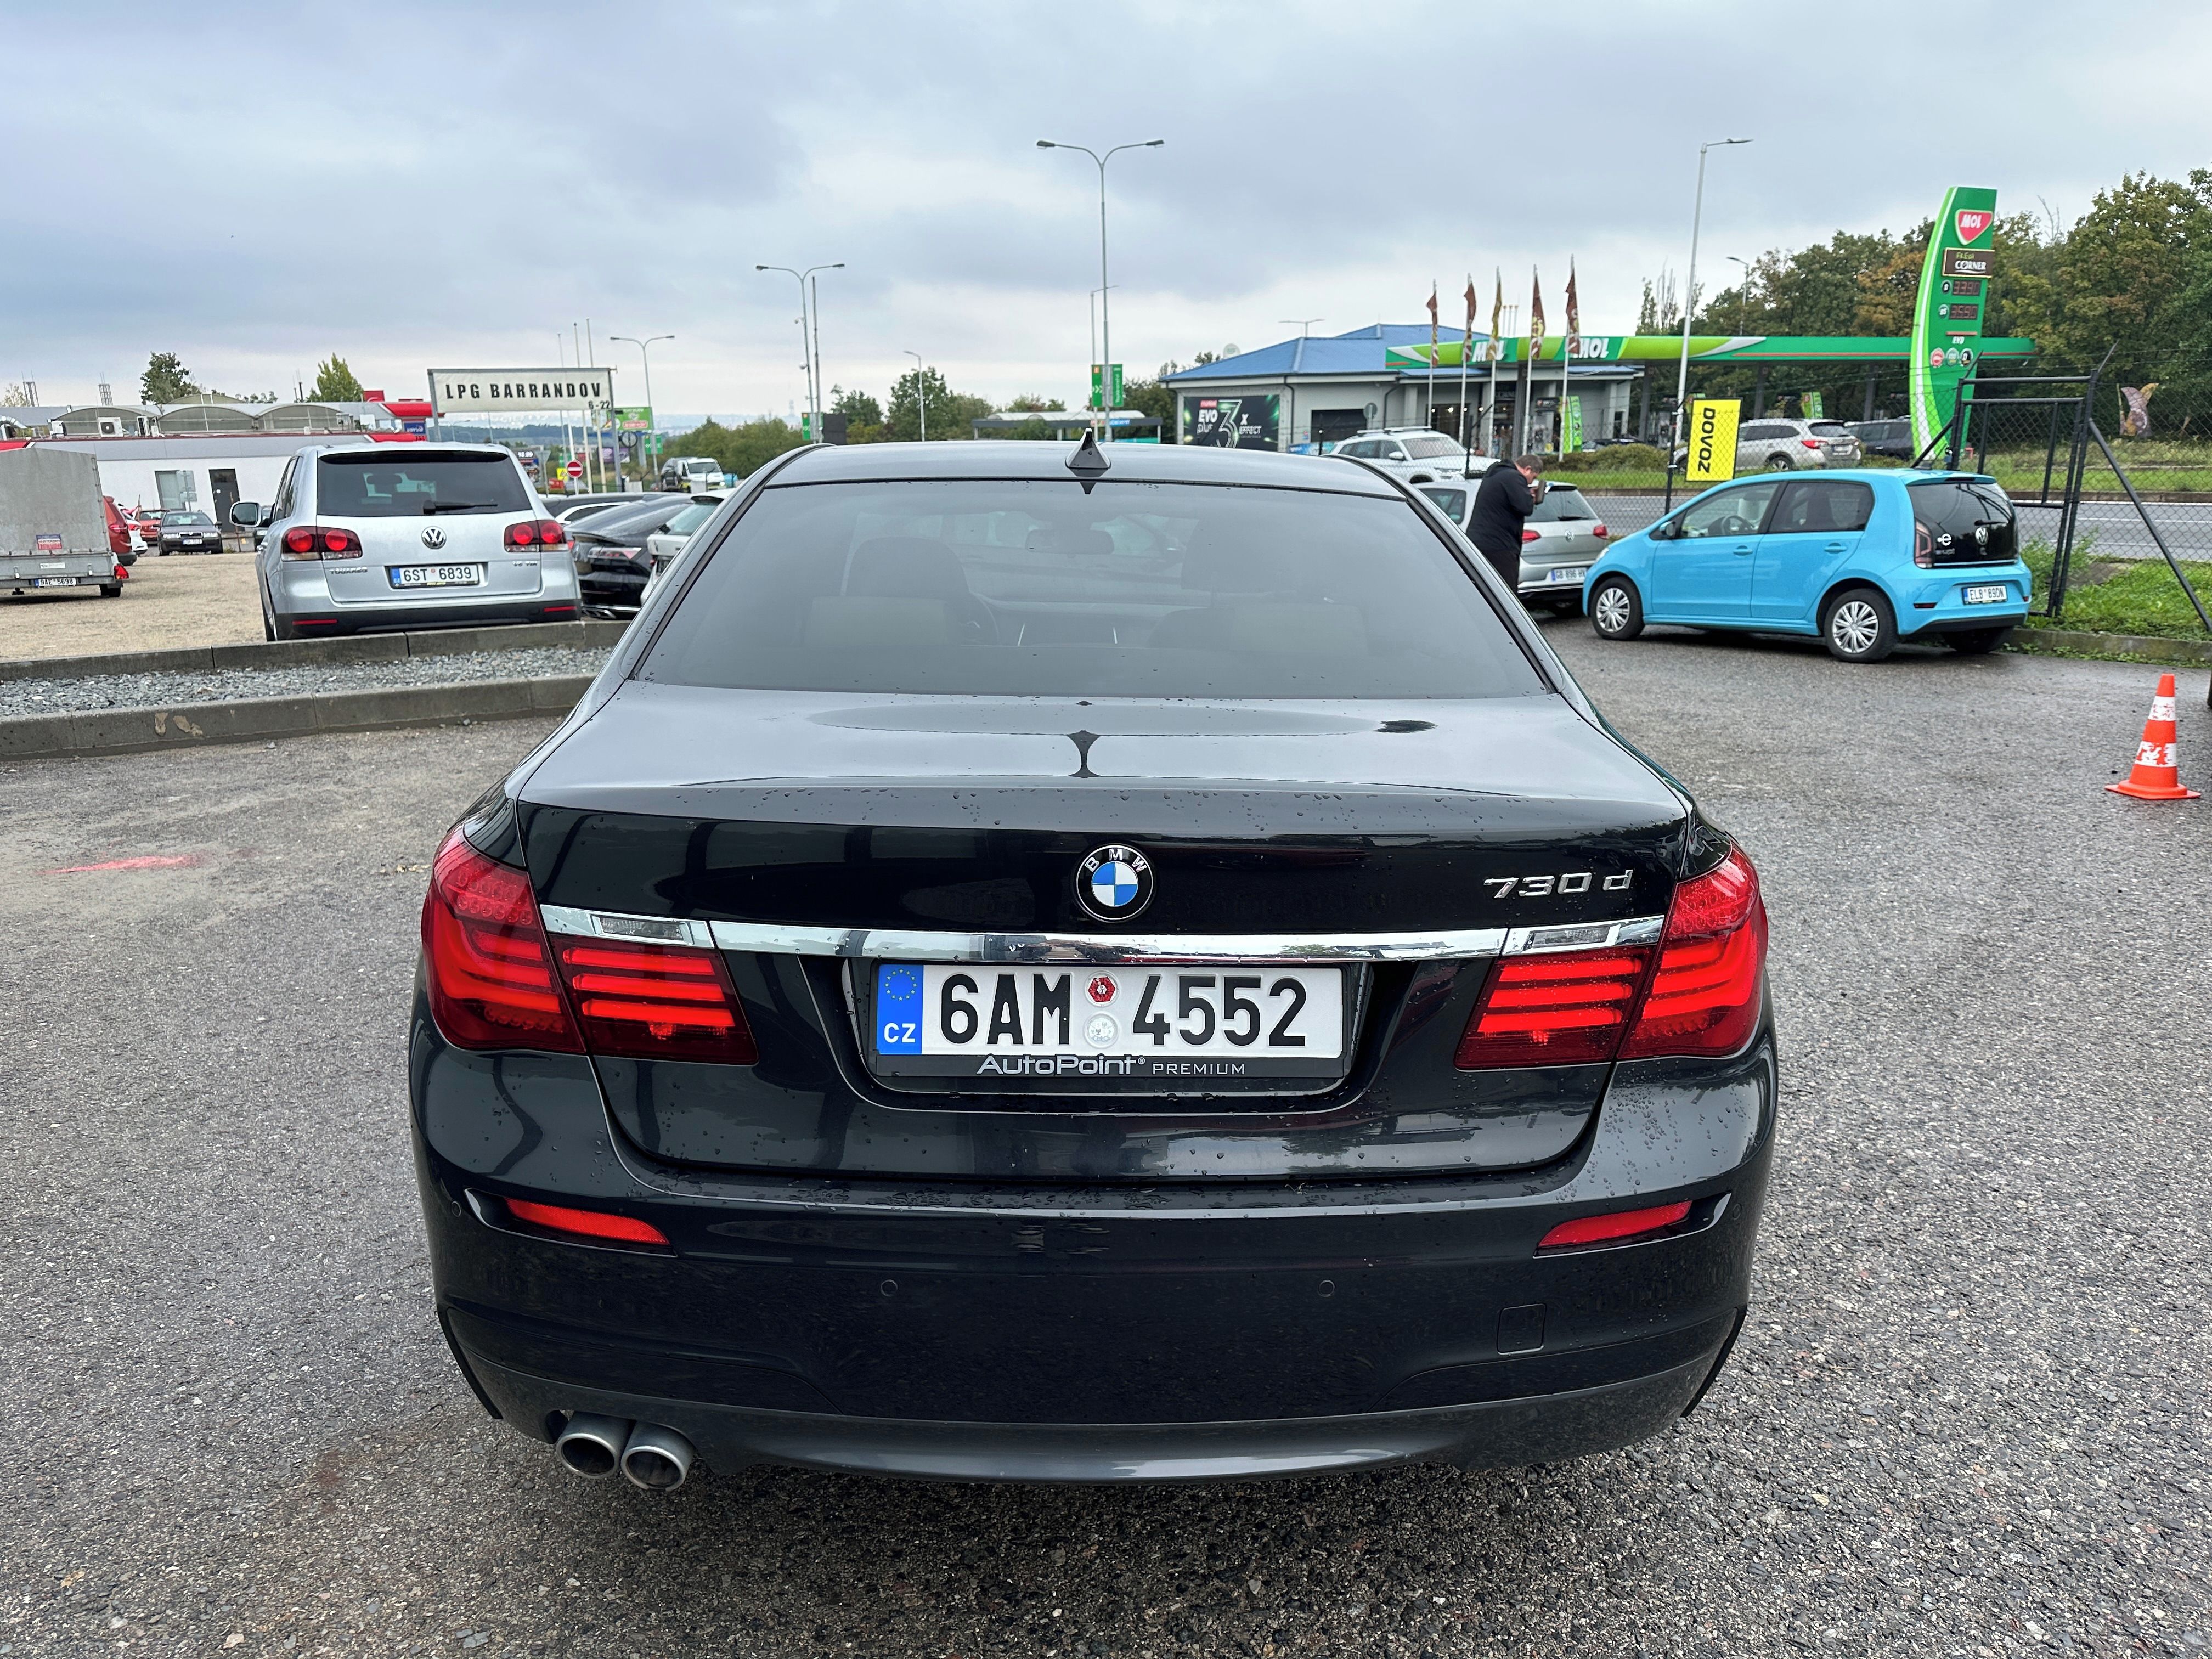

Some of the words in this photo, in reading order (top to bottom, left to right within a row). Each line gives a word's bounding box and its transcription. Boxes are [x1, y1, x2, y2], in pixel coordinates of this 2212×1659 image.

[1960, 214, 1982, 228] MOL
[1954, 260, 1987, 270] CORNER
[1472, 340, 1505, 362] ML
[445, 384, 480, 399] LPG
[490, 383, 601, 399] BARRANDOV
[1198, 409, 1218, 422] EVO
[1239, 425, 1262, 435] EFFECT
[1697, 407, 1716, 473] DOVOZ
[403, 569, 428, 582] 6ST
[438, 567, 472, 582] 6839
[1084, 848, 1147, 872] BMW
[883, 1022, 916, 1043] CZ
[941, 973, 1071, 1045] 6AM
[1133, 975, 1307, 1046] 4552
[1152, 1063, 1245, 1075] PREMIUM
